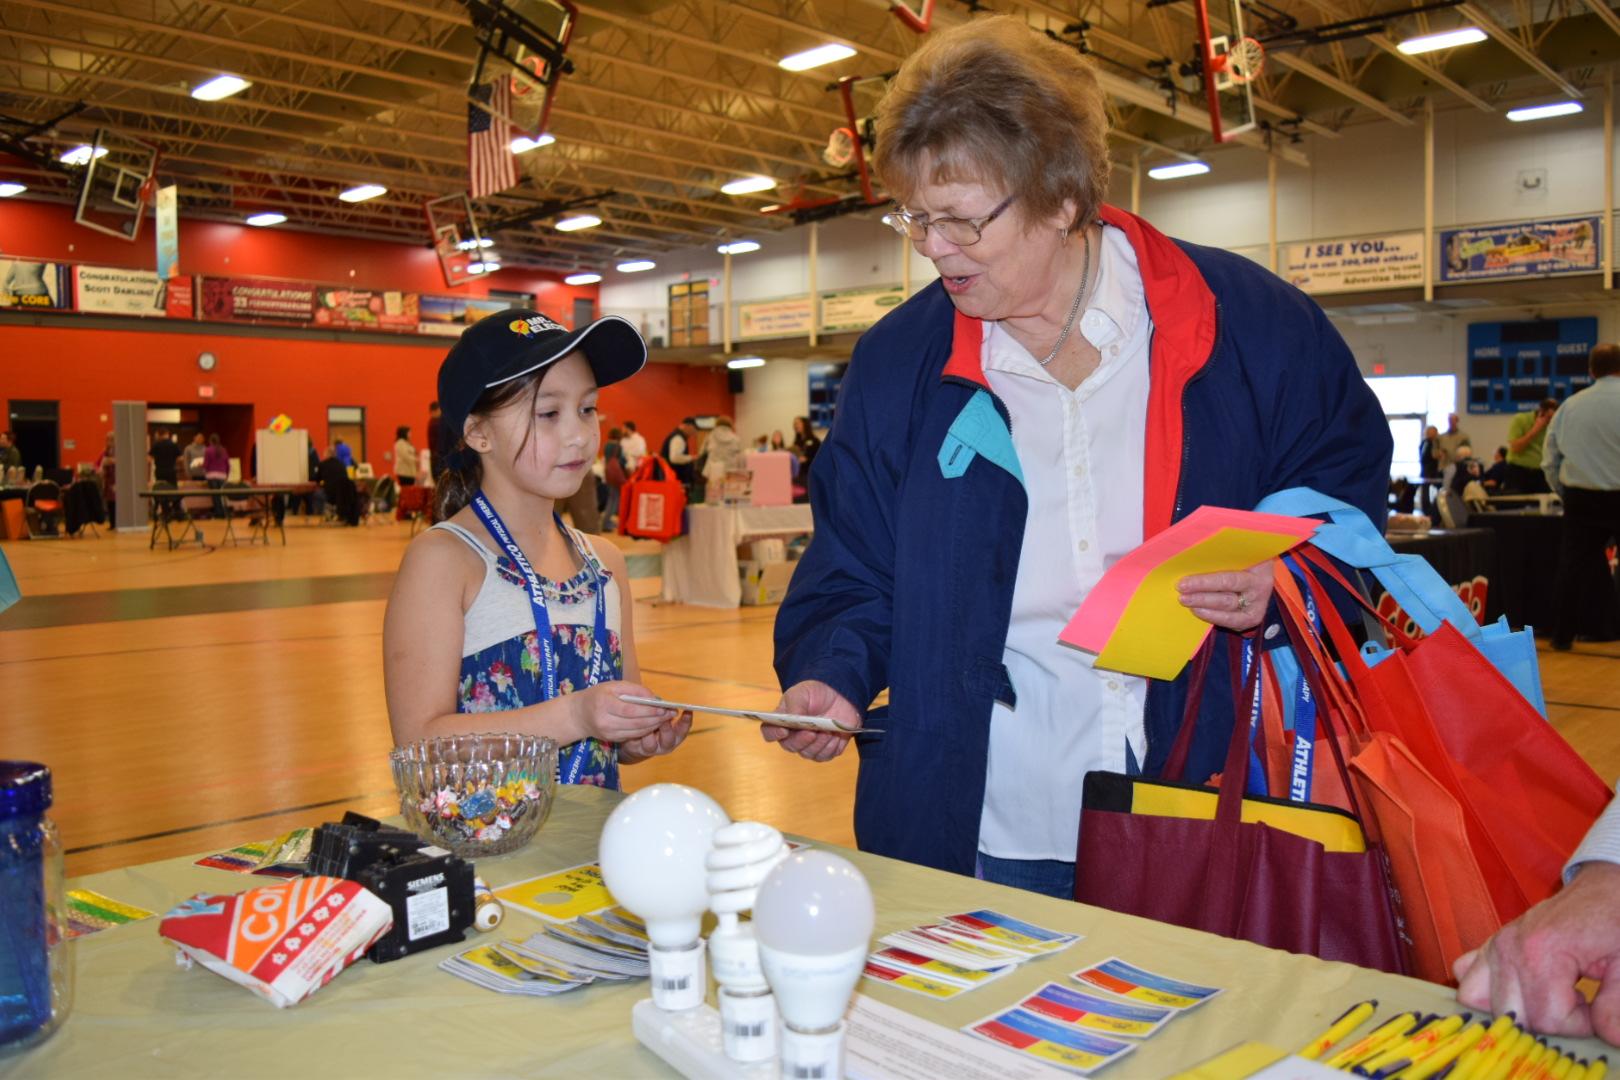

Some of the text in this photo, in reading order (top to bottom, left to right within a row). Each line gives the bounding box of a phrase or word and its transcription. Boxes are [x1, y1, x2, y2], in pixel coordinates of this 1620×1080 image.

[1305, 240, 1401, 259] I SEE YOU...
[21, 295, 50, 306] CORE
[1556, 342, 1588, 354] GUEST
[588, 639, 603, 689] ATHLE
[566, 754, 582, 785] THERAP
[1291, 735, 1312, 802] ATHLETI
[407, 872, 446, 892] SIEMENS
